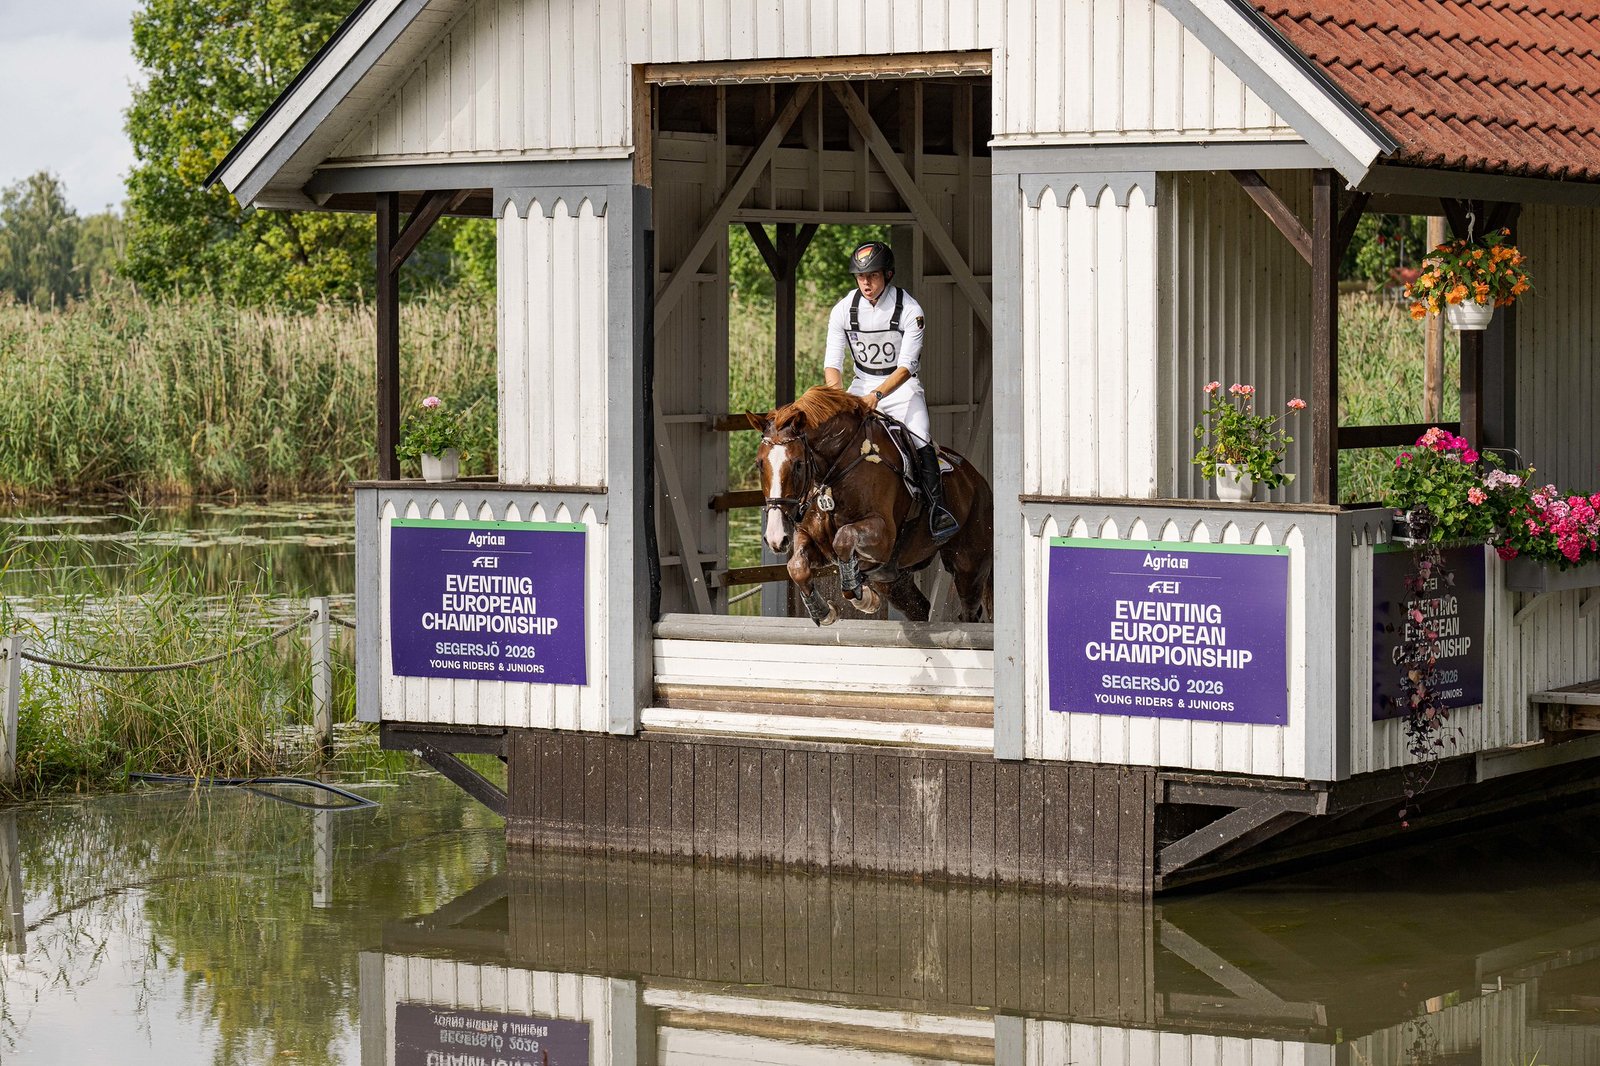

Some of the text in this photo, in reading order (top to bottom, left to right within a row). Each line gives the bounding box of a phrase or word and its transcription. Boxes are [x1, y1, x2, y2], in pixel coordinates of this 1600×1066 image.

[856, 341, 896, 364] 329
[468, 532, 498, 547] Agria
[472, 556, 499, 568] FEI
[1143, 553, 1179, 571] Agria
[446, 574, 533, 595] EVENTING
[1147, 581, 1181, 594] FEI
[442, 594, 536, 615] EUROPEAN
[1115, 600, 1222, 624] EVENTING
[421, 612, 558, 635] CHAMPIONSHIP
[1110, 621, 1226, 646] EUROPEAN
[435, 642, 536, 659] SEGERSJÖ 2026
[1085, 641, 1253, 669] CHAMPIONSHIP
[1392, 636, 1471, 665] CPONSHIP
[429, 659, 545, 673] YOUNG RIDERS & JUNIORS
[1101, 674, 1224, 695] SEGERSJÖ 2026
[1440, 669, 1458, 685] 2026
[1094, 693, 1235, 712] YOUNG RIDERS & JUNIORS
[1440, 687, 1463, 700] JUNIORS
